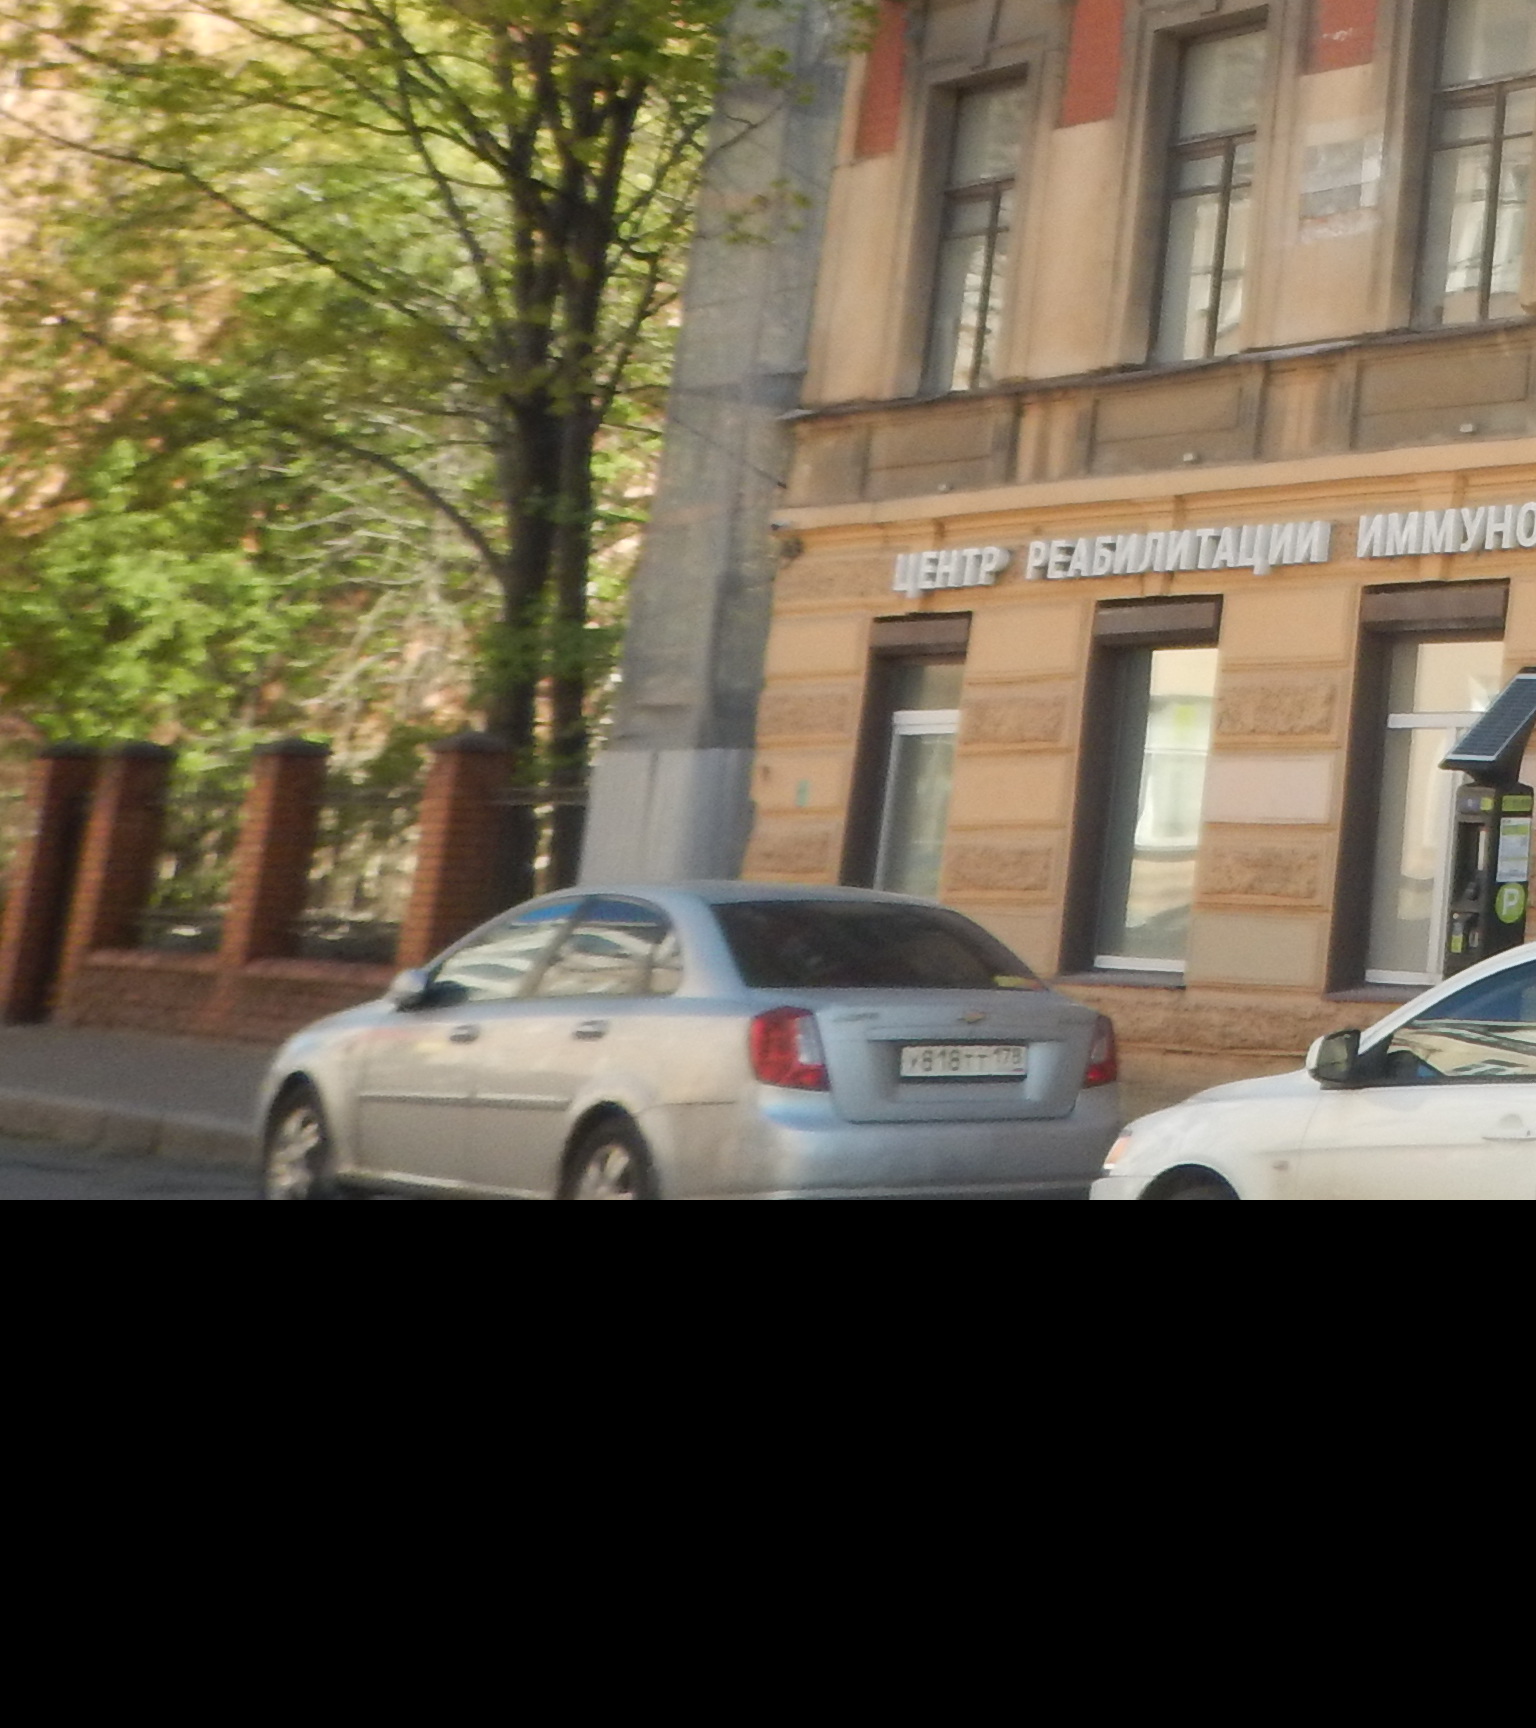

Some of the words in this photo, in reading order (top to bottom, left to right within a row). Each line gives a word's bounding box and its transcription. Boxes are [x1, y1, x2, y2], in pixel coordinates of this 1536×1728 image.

[893, 546, 1009, 598] ЦЕНТР
[1025, 520, 1331, 575] РЕАБИЛИТАЦИИ
[1502, 888, 1520, 916] P
